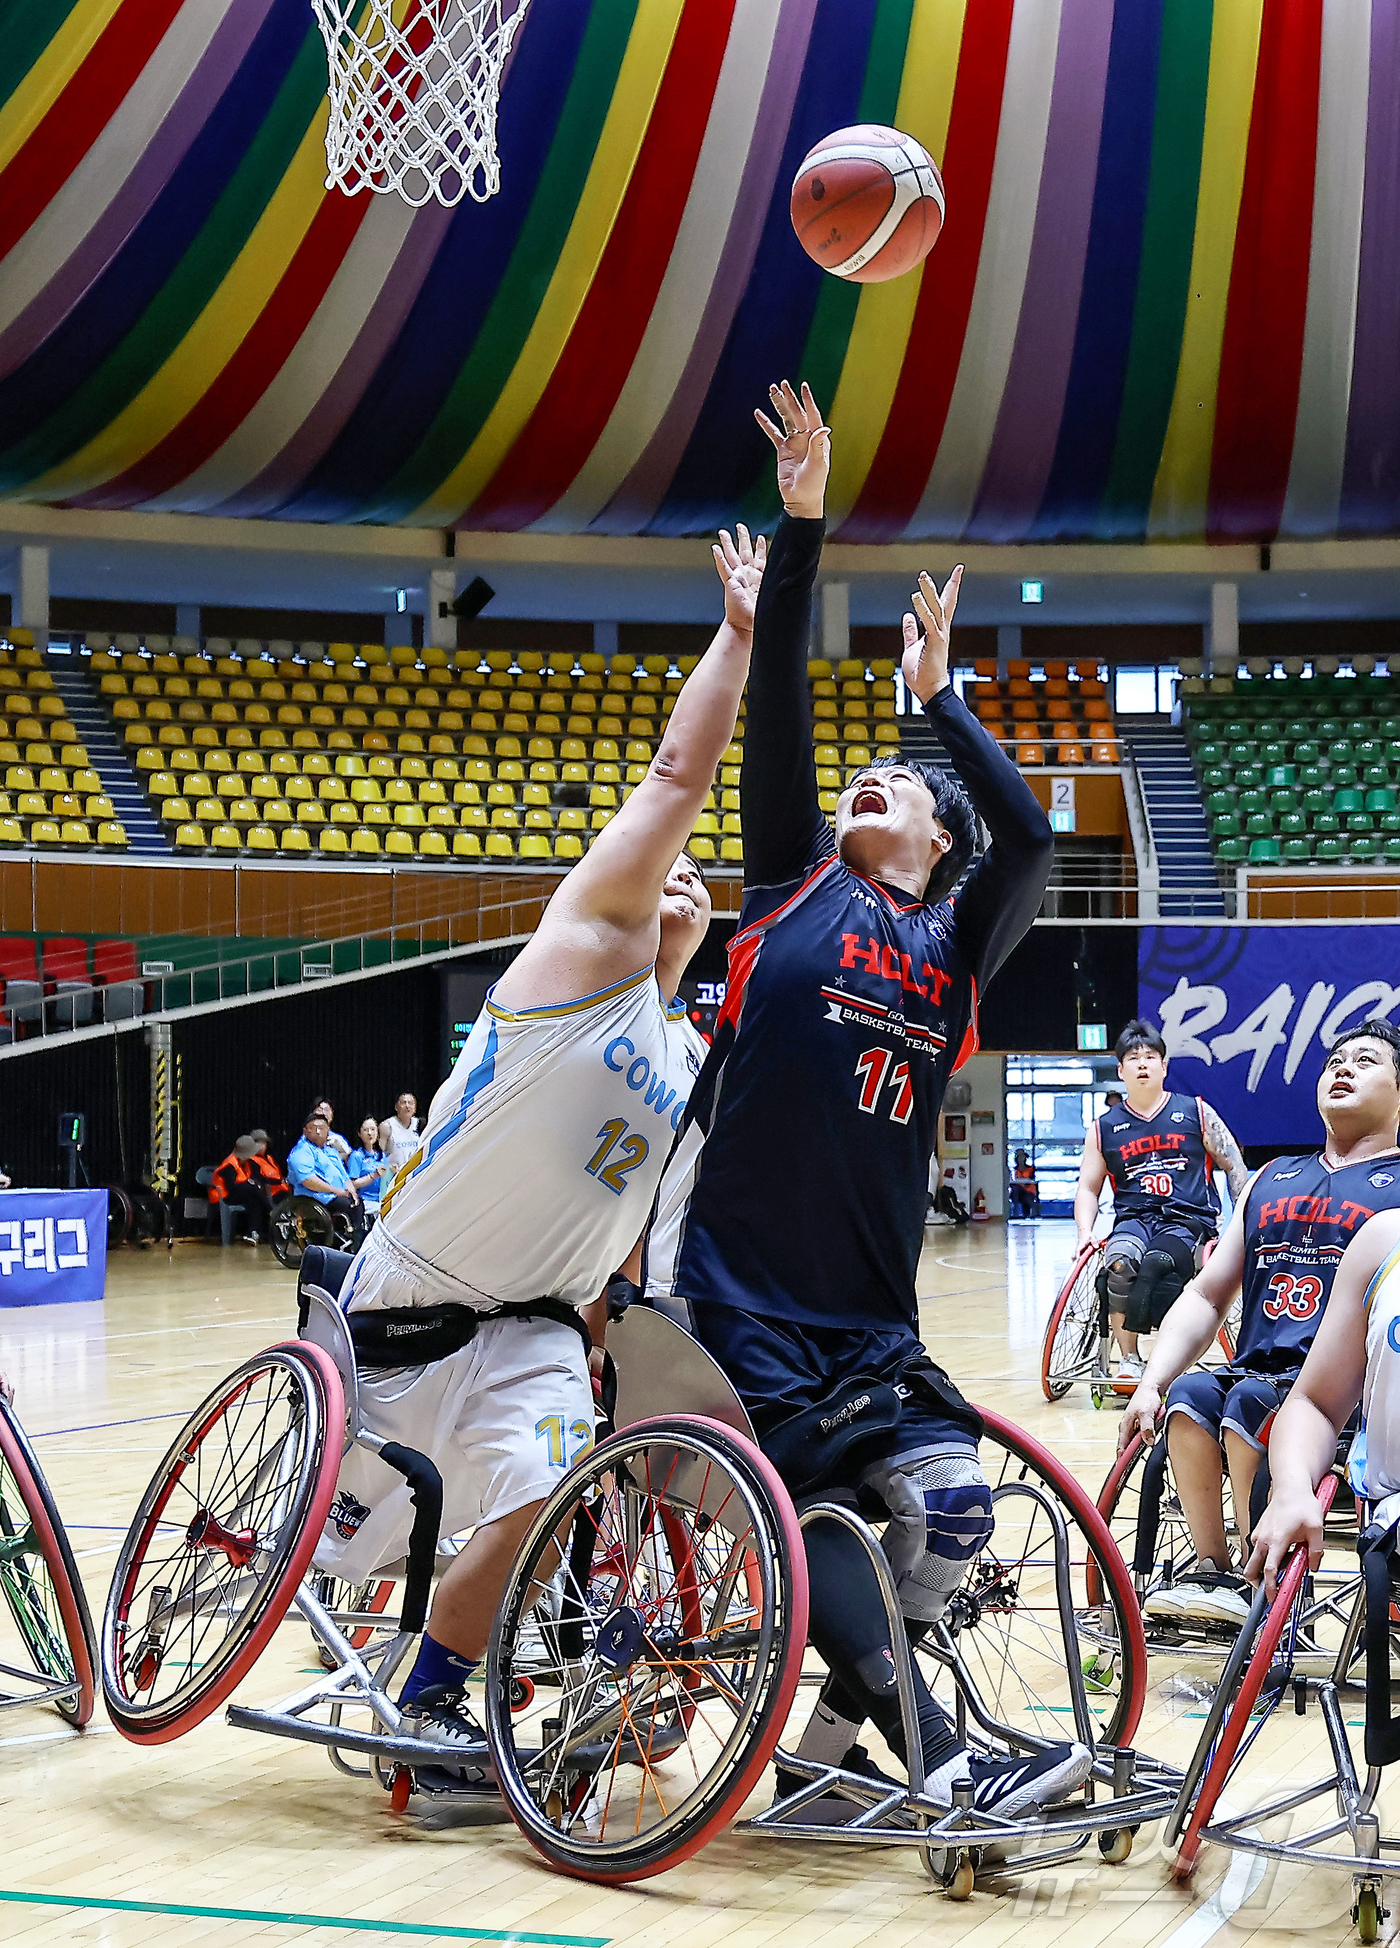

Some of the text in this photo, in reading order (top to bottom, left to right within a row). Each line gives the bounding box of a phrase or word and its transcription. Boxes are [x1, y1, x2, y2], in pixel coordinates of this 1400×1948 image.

[1057, 784, 1069, 804] 2
[839, 932, 953, 1007] HOLT
[854, 1046, 914, 1125] 11
[584, 1117, 650, 1196] 12
[1118, 1133, 1186, 1161] HOLT
[1140, 1173, 1173, 1197] 30
[1258, 1195, 1375, 1230] HOLT
[1262, 1272, 1324, 1322] 33
[535, 1415, 594, 1470] 12
